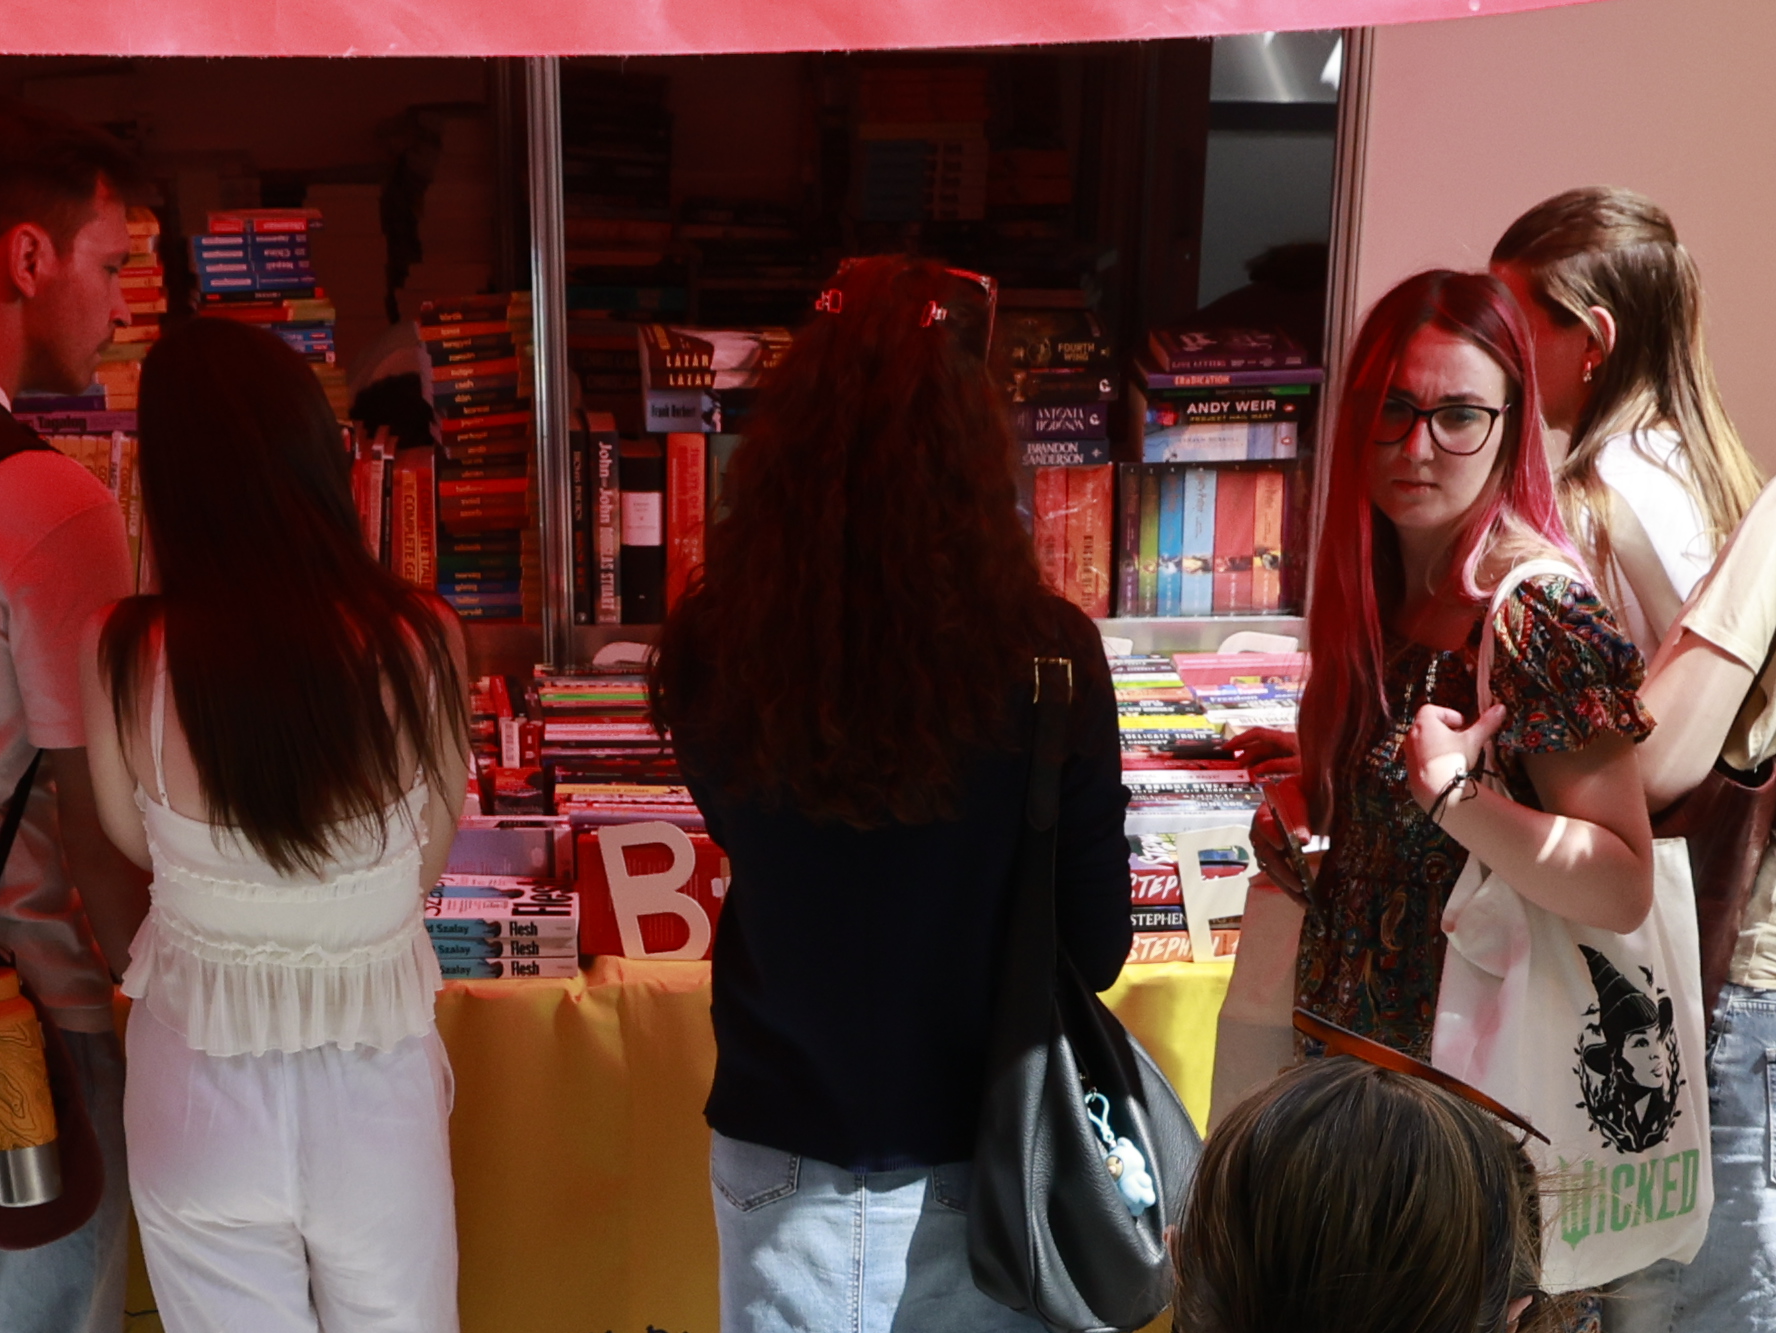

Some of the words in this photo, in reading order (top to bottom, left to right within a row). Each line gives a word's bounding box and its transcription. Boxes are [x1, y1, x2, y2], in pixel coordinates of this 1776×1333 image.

[1186, 402, 1231, 415] ANDY
[1235, 400, 1277, 412] WEIR
[599, 441, 613, 479] John
[598, 821, 711, 960] B
[436, 923, 469, 936] Szalay
[509, 920, 538, 937] Flesh
[1558, 1147, 1702, 1254] WICKED
